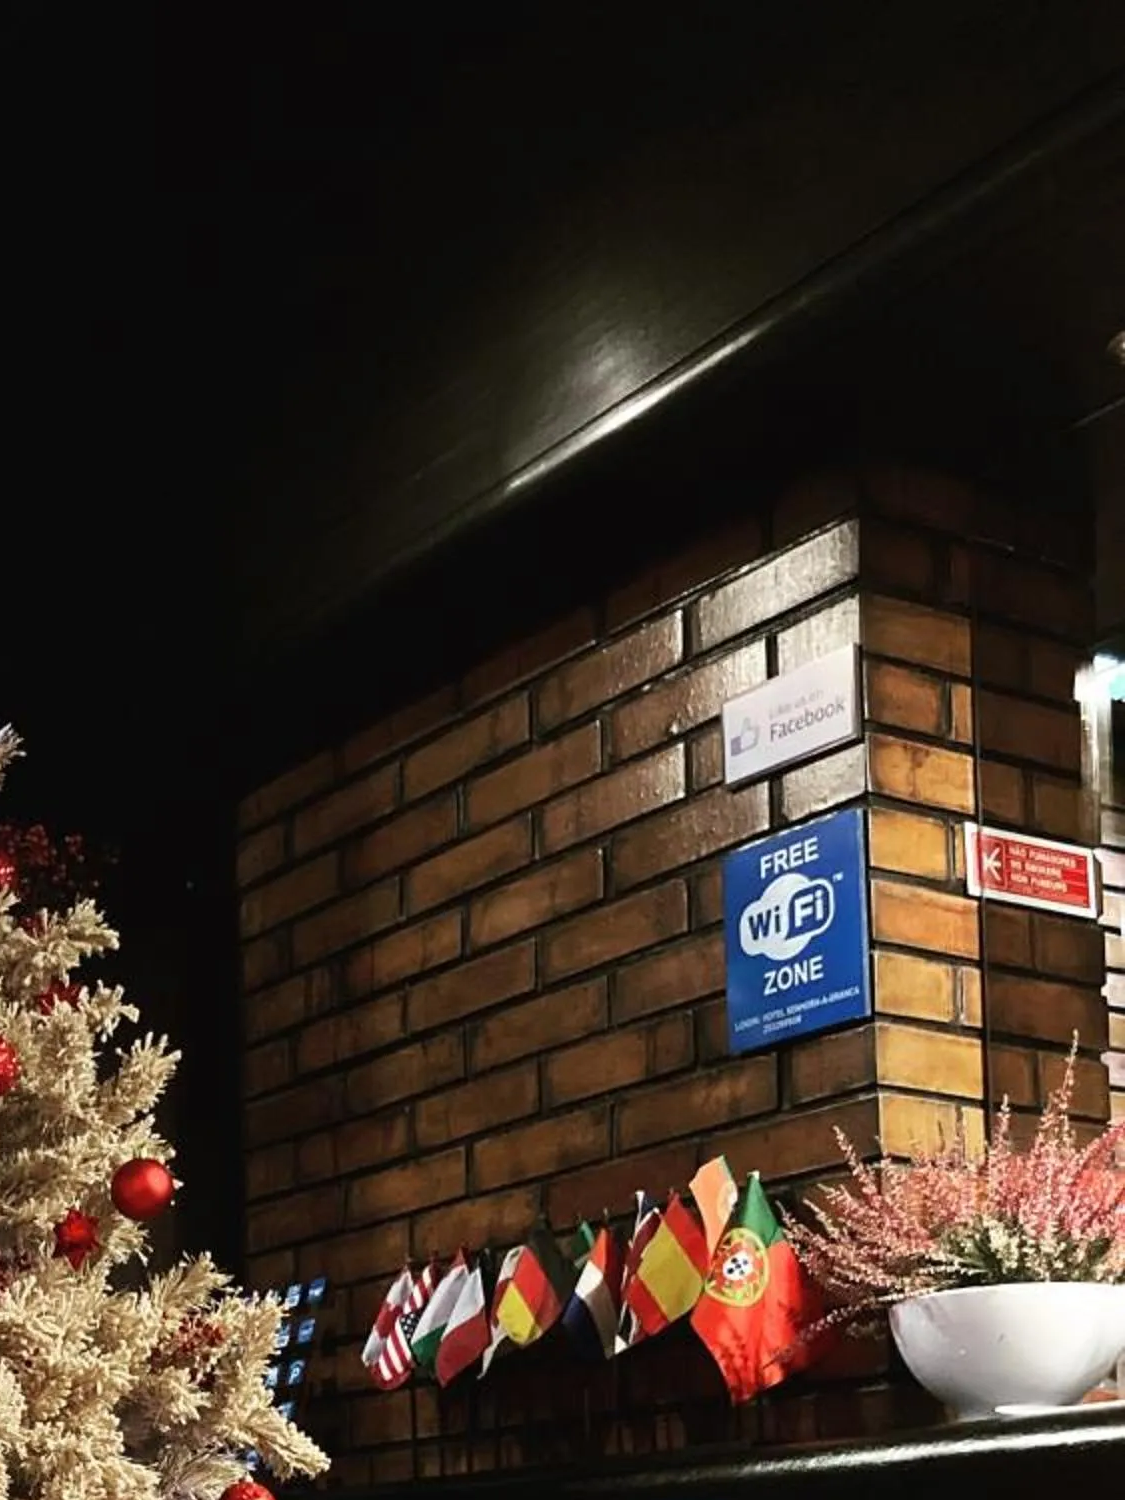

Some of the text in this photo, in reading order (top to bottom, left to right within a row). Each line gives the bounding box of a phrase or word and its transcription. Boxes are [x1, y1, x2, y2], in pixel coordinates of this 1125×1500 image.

[769, 696, 845, 742] Facebook
[760, 836, 819, 879] FREE
[764, 955, 825, 996] ZONE
